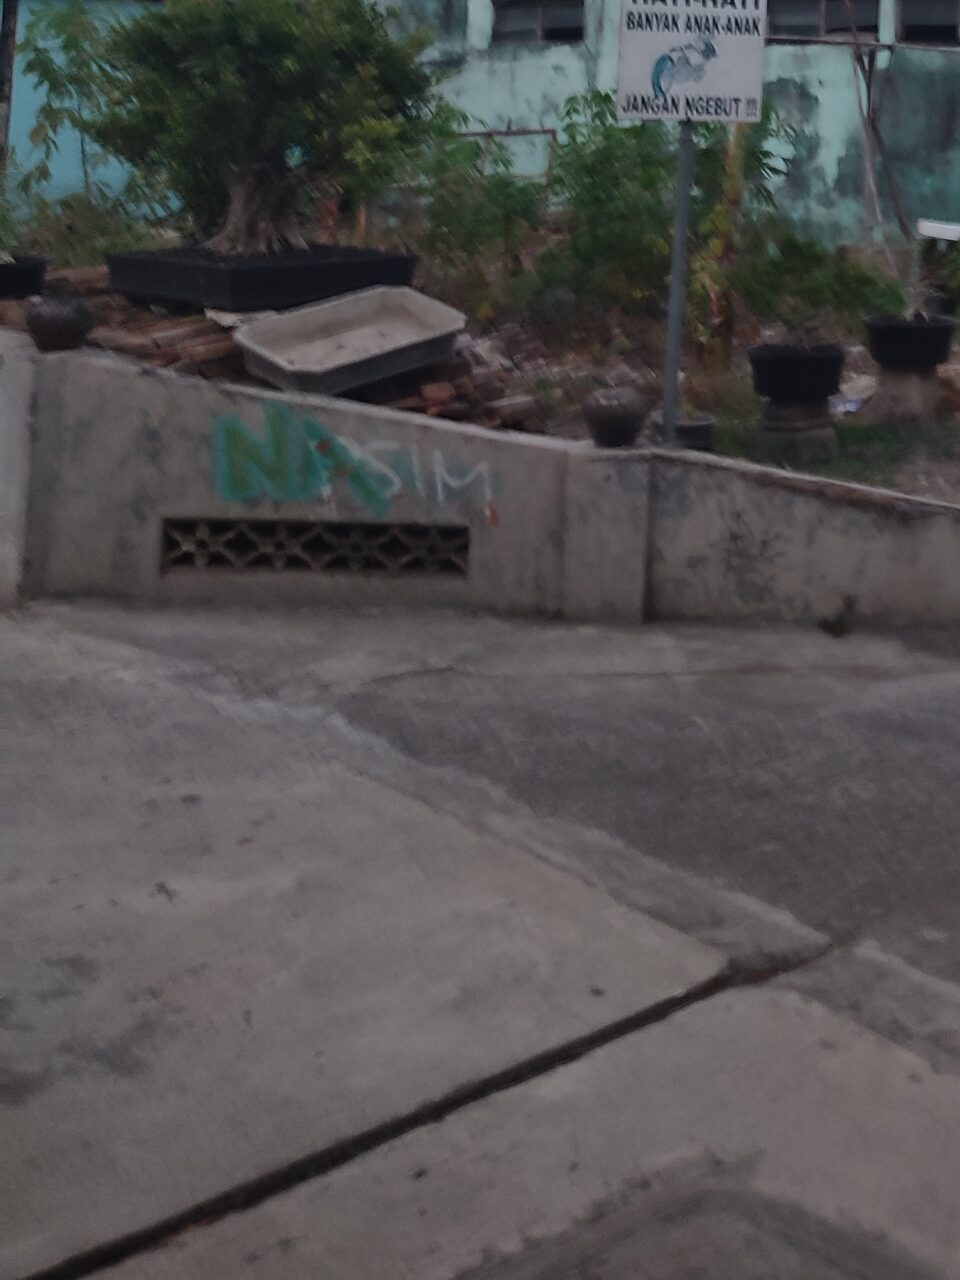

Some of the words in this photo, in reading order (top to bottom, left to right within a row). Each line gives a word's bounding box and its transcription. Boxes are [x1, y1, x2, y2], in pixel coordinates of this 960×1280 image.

[627, 11, 680, 32] BANYAK
[685, 14, 761, 36] ANAK-ANAK
[621, 94, 680, 115] JANGAN
[684, 95, 741, 117] NGEBUT
